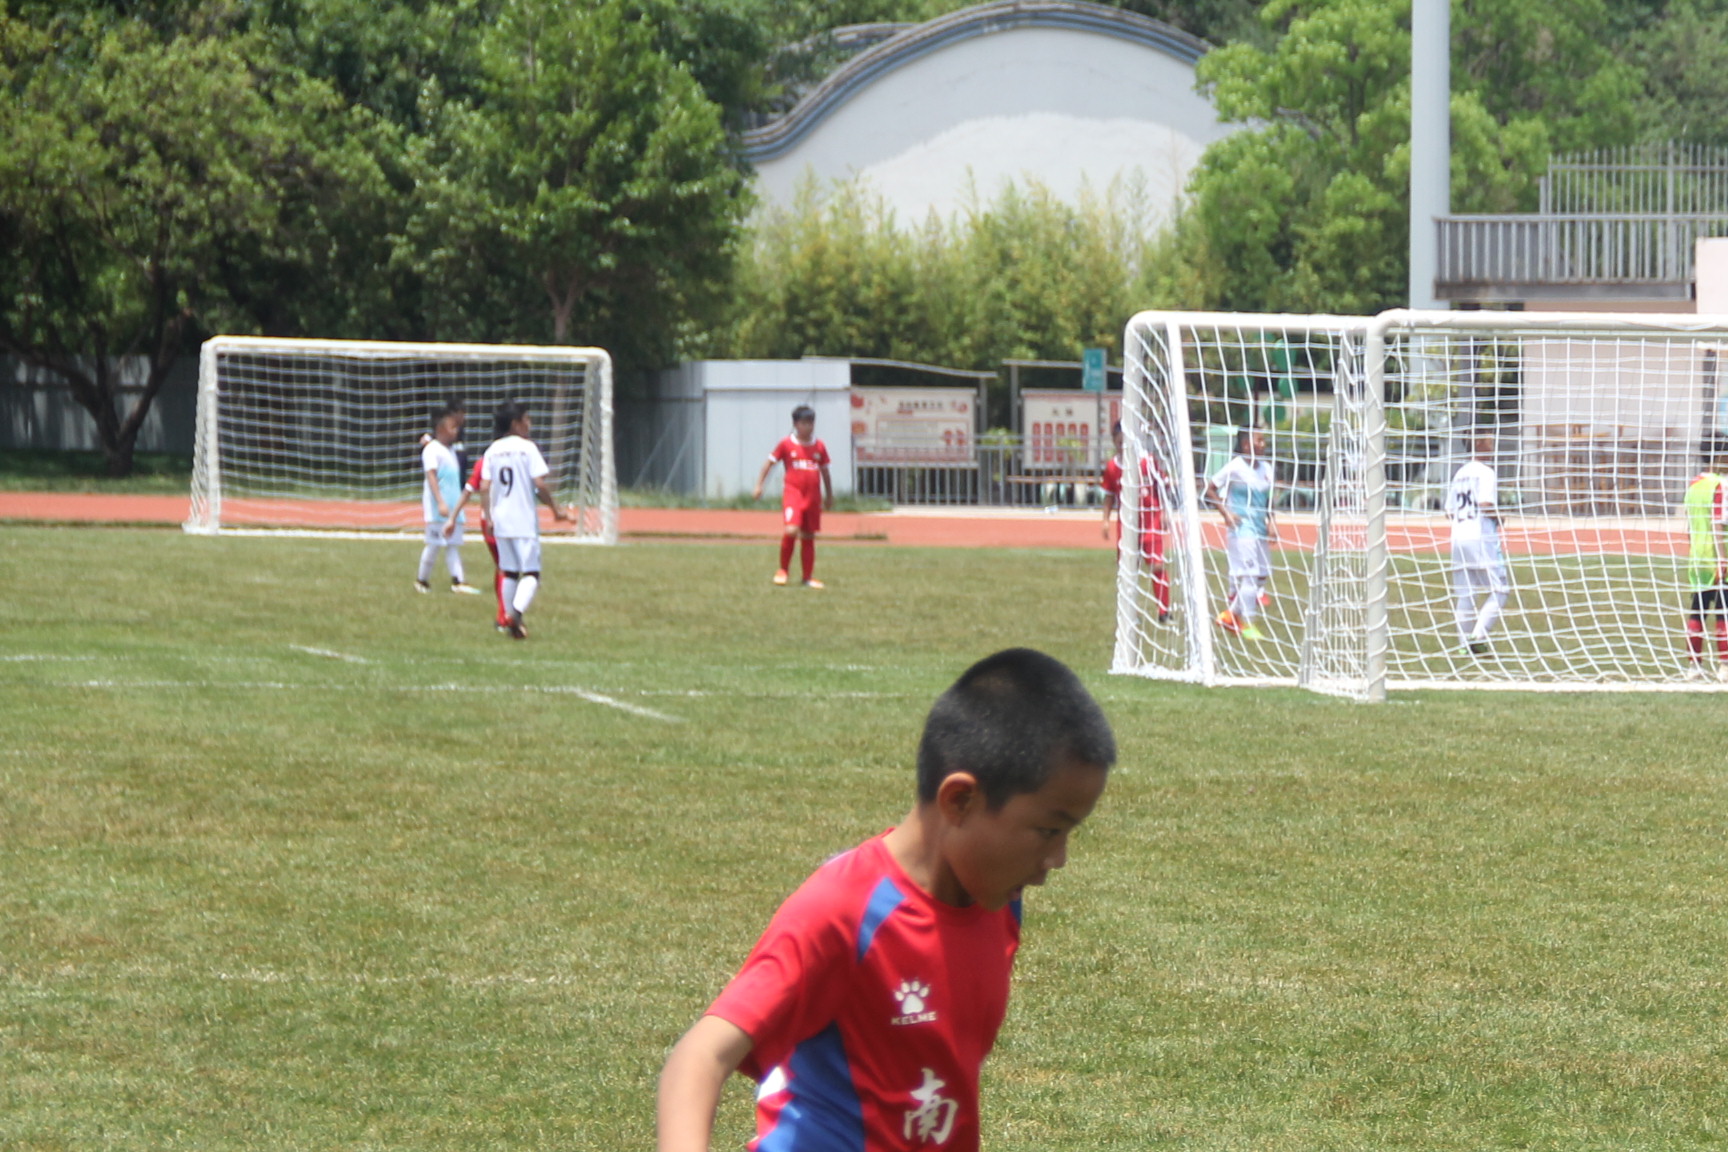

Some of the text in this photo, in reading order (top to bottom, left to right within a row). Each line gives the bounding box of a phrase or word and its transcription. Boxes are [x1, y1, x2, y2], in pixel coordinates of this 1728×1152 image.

[499, 466, 514, 498] 9
[891, 1011, 937, 1025] KELME
[904, 1067, 958, 1145] 南
